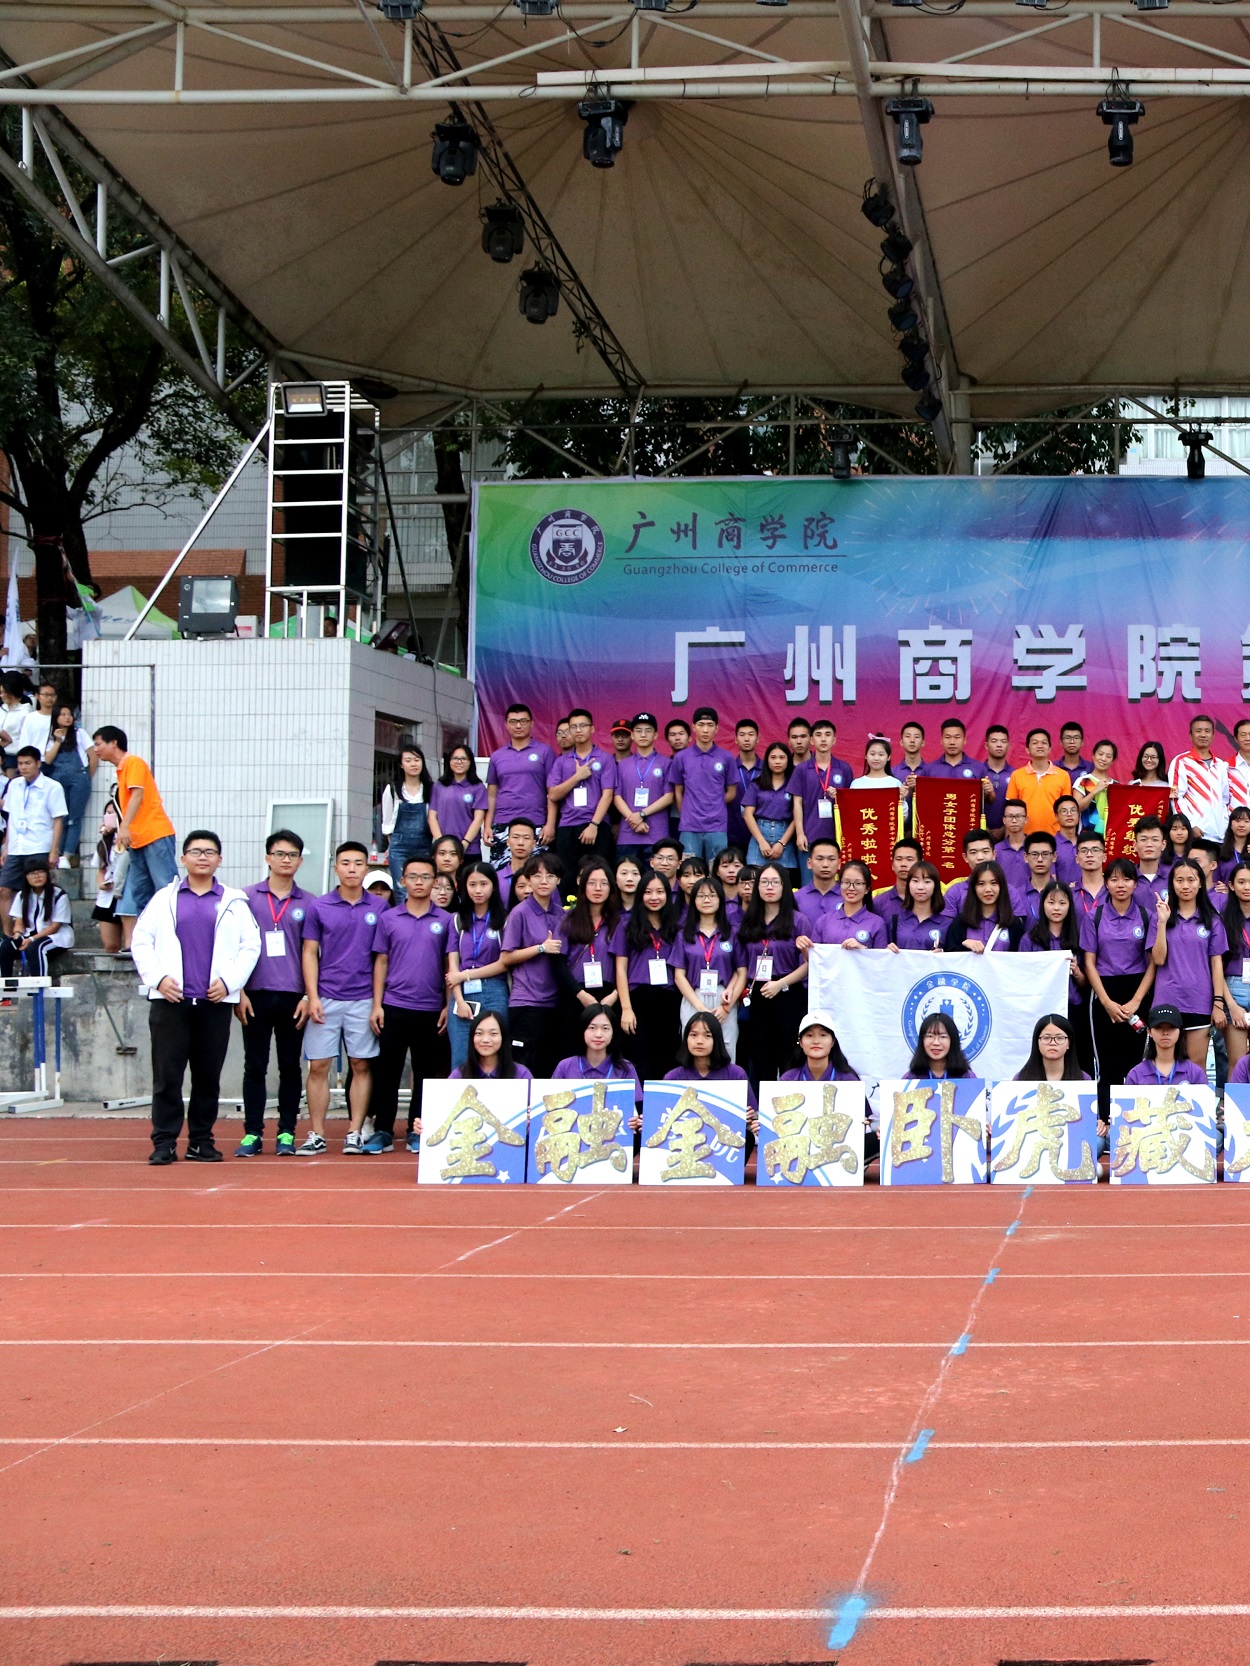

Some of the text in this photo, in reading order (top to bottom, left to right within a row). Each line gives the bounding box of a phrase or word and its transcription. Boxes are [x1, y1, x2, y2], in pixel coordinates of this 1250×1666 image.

[555, 529, 580, 537] GCC
[624, 511, 839, 553] 广州商学院
[531, 543, 553, 579] GUANGZHOU
[552, 575, 580, 584] COLLEGE
[587, 541, 604, 574] COMMERCE
[623, 561, 839, 578] Guangzhou College of Commerce
[860, 808, 878, 880] 优秀啦啦
[941, 793, 958, 869] 男女子团体总分第一名
[925, 977, 972, 992] 金融学院
